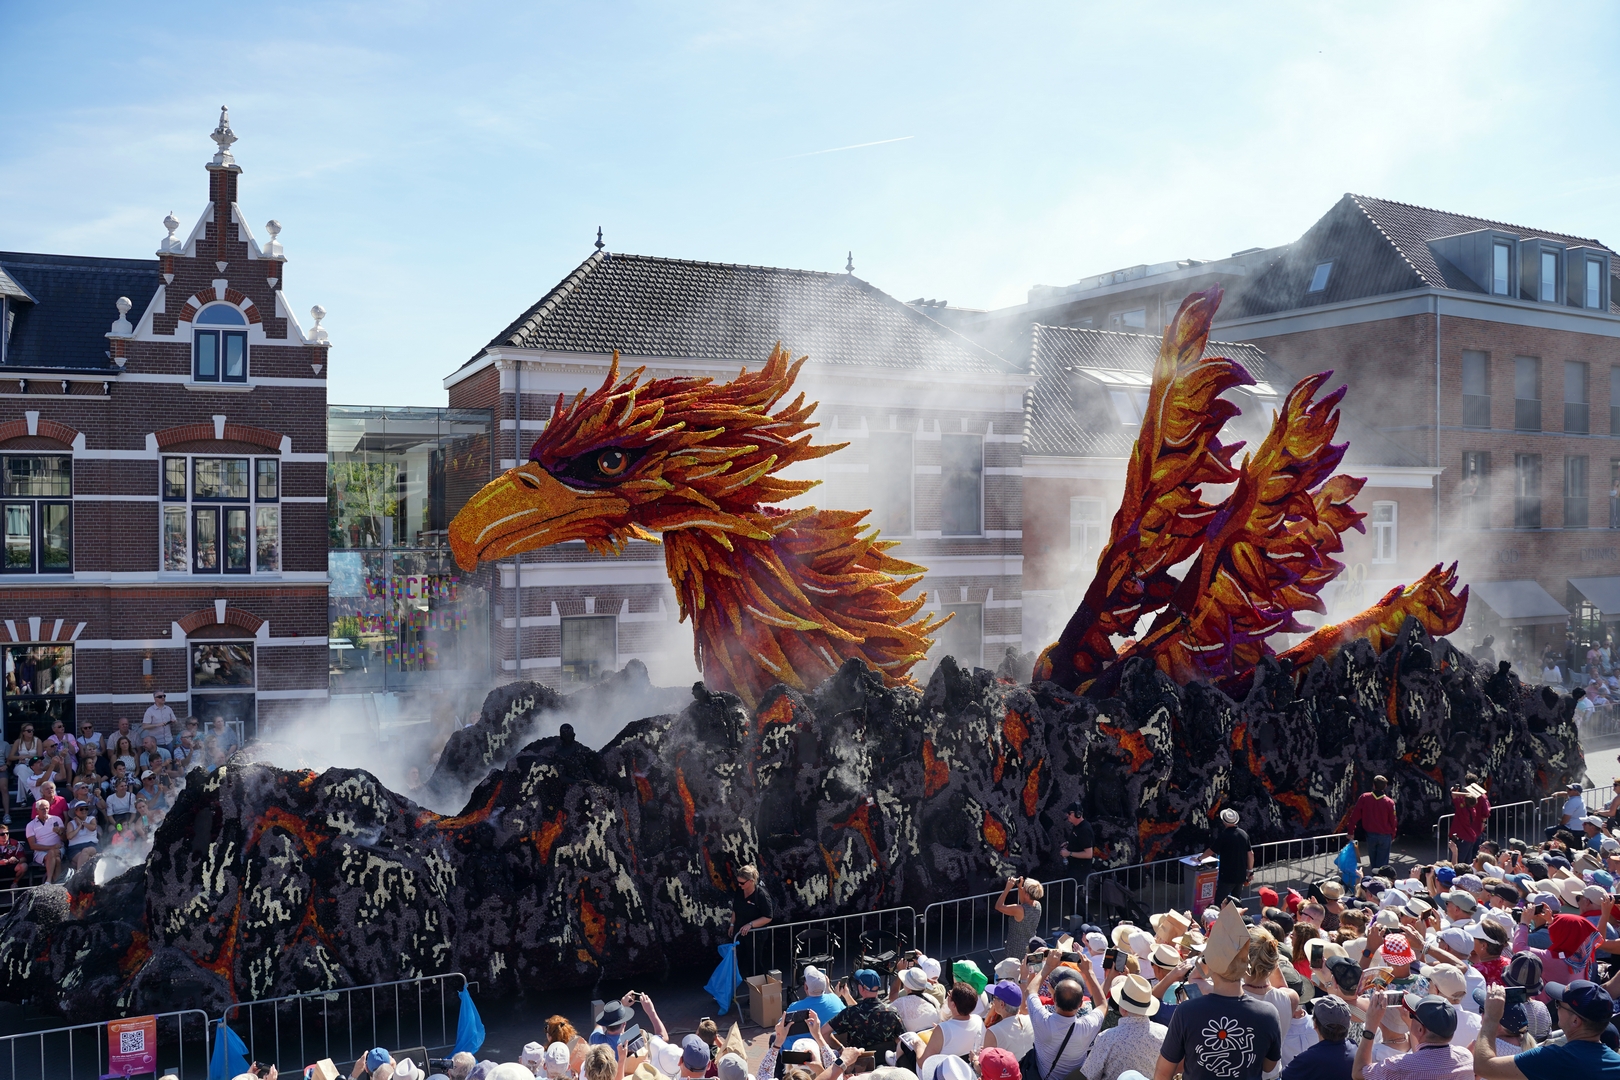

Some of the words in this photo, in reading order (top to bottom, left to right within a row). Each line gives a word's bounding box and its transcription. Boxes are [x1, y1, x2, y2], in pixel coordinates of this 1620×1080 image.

[1580, 546, 1618, 562] DRINKS
[365, 577, 460, 601] VINCENT
[357, 610, 400, 633] VAN
[409, 609, 467, 632] GOGH
[386, 641, 439, 665] HUIS
